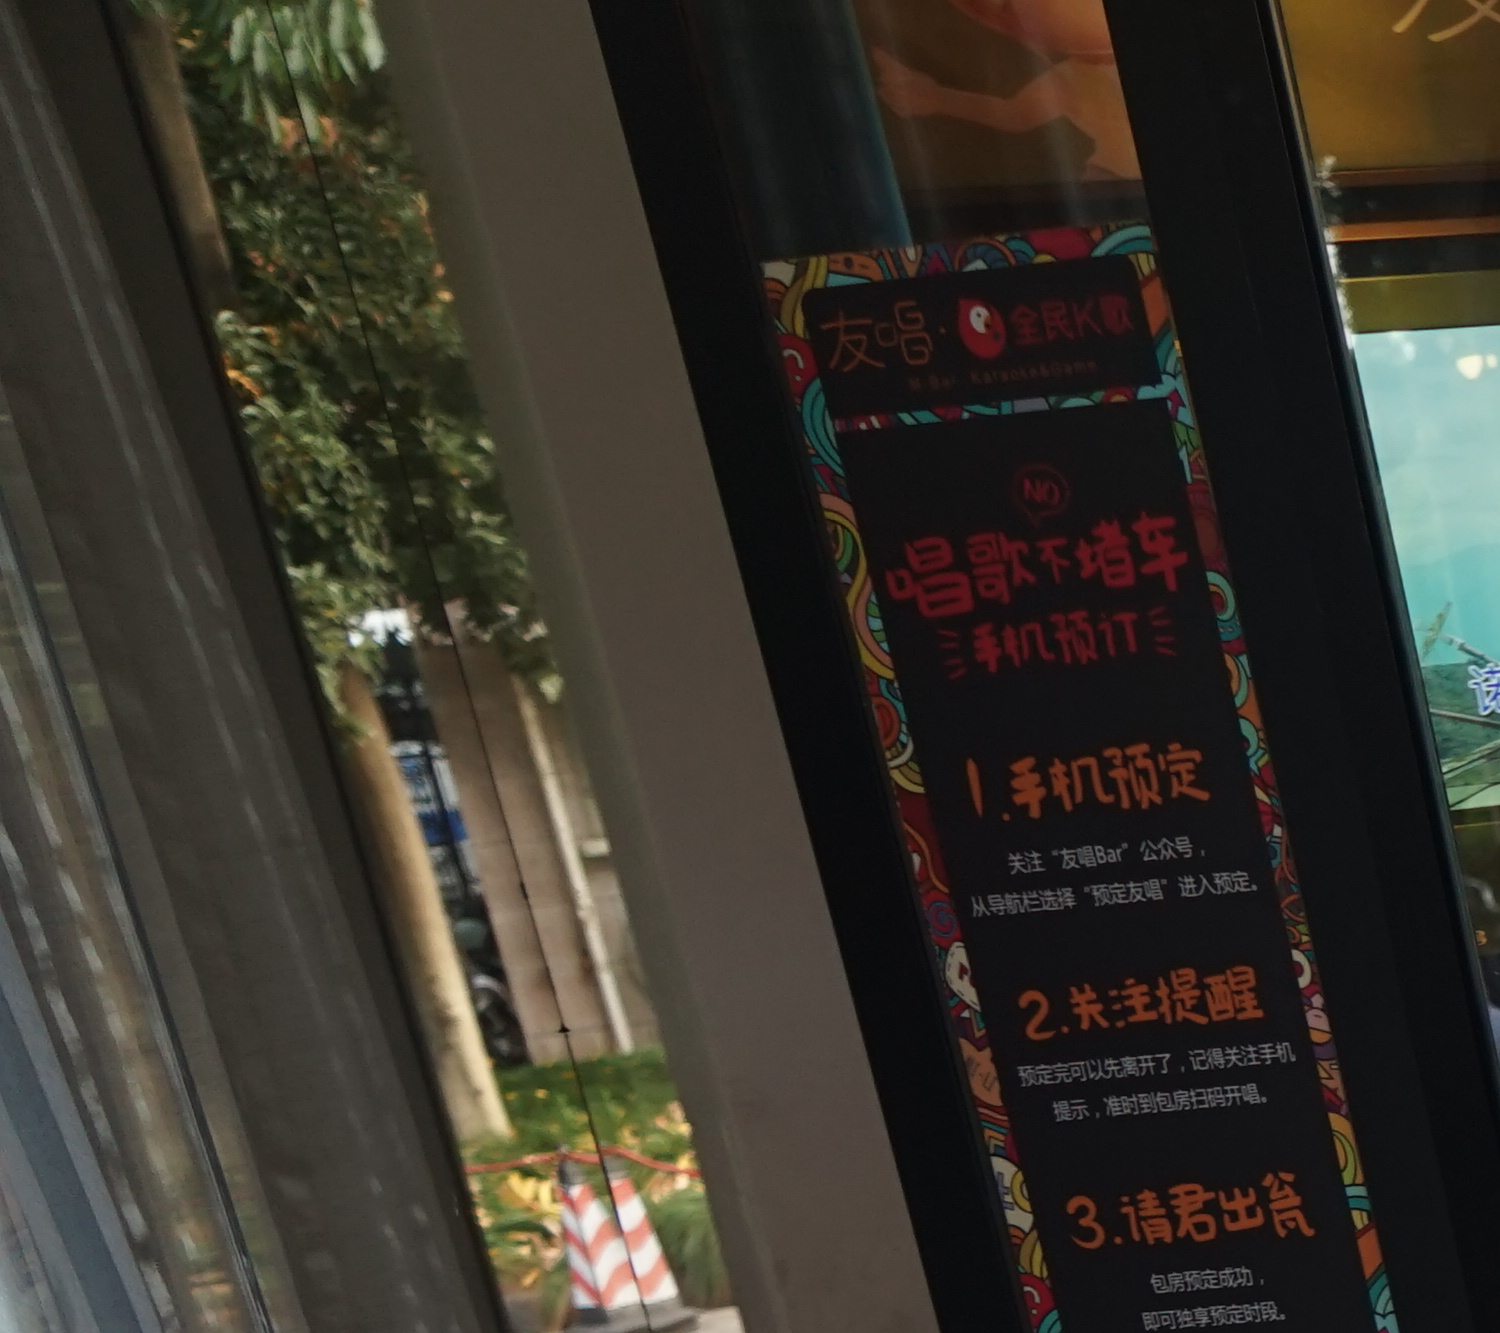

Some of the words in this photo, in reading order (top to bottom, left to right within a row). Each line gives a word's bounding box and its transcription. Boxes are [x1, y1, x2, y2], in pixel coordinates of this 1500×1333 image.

[820, 299, 934, 373] 友唱
[1009, 293, 1135, 347] 全民K歌
[1022, 477, 1062, 508] NO
[884, 510, 1189, 619] 唱歌不堵车
[971, 607, 1140, 675] 手机预订
[965, 741, 1212, 822] 1.手机预定
[1018, 963, 1265, 1042] 2.关注提醒
